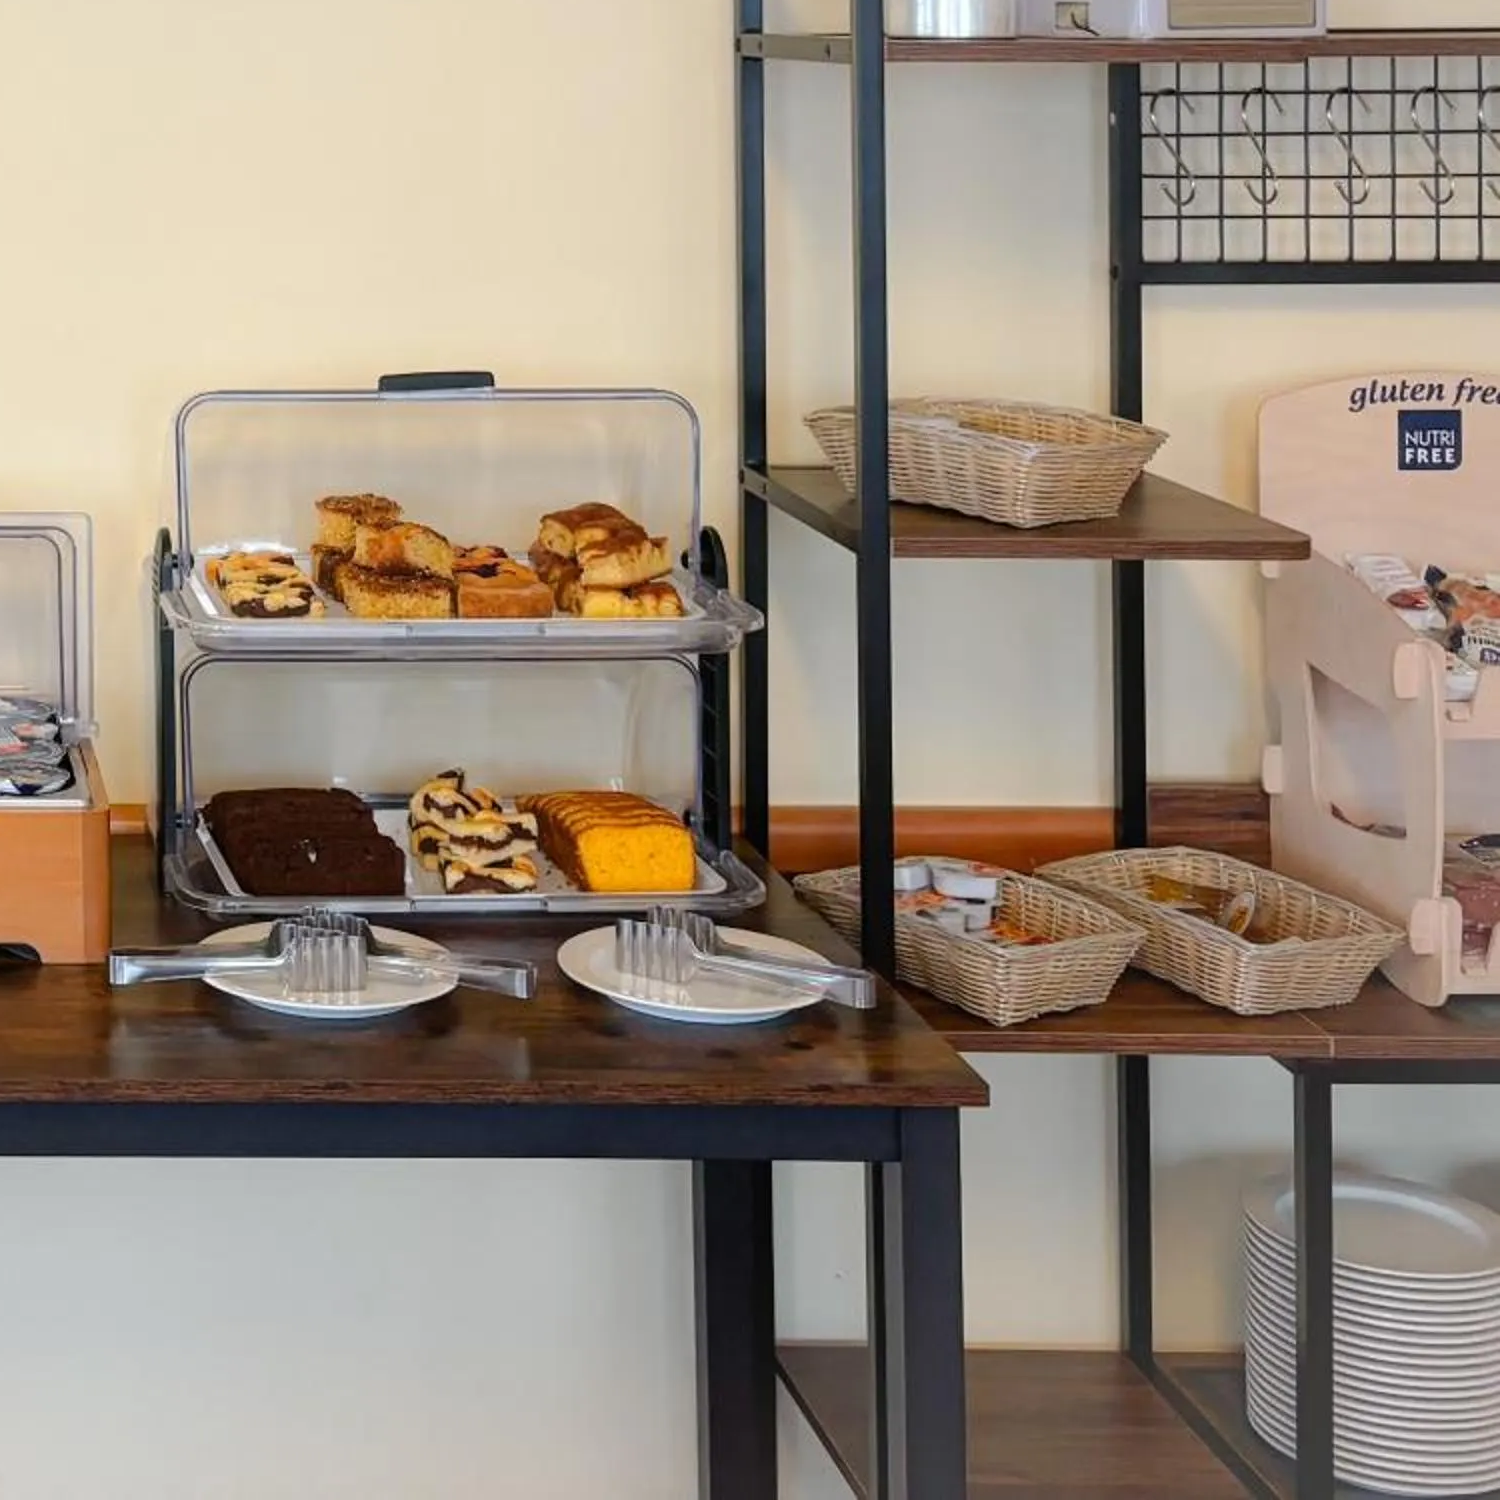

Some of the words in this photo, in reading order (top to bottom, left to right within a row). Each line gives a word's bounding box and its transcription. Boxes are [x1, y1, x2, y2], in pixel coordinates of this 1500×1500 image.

[1348, 379, 1445, 412] gluten
[1405, 430, 1455, 447] NUTRI
[1405, 448, 1455, 463] FREE
